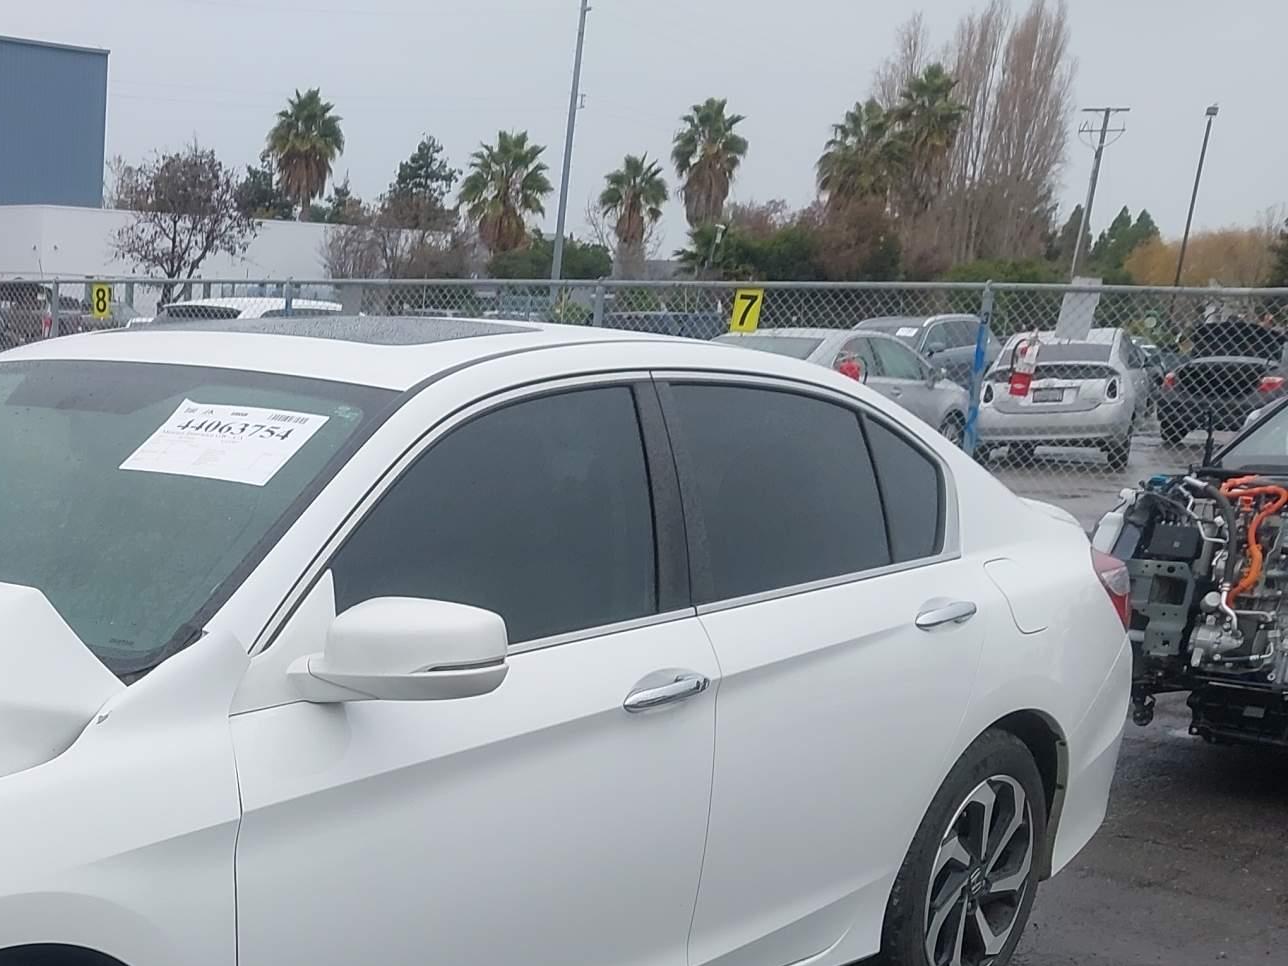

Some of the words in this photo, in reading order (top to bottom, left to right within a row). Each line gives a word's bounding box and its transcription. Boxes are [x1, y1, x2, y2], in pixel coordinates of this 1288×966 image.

[96, 288, 107, 313] 8
[739, 293, 760, 327] 7
[177, 418, 296, 441] 44063754
